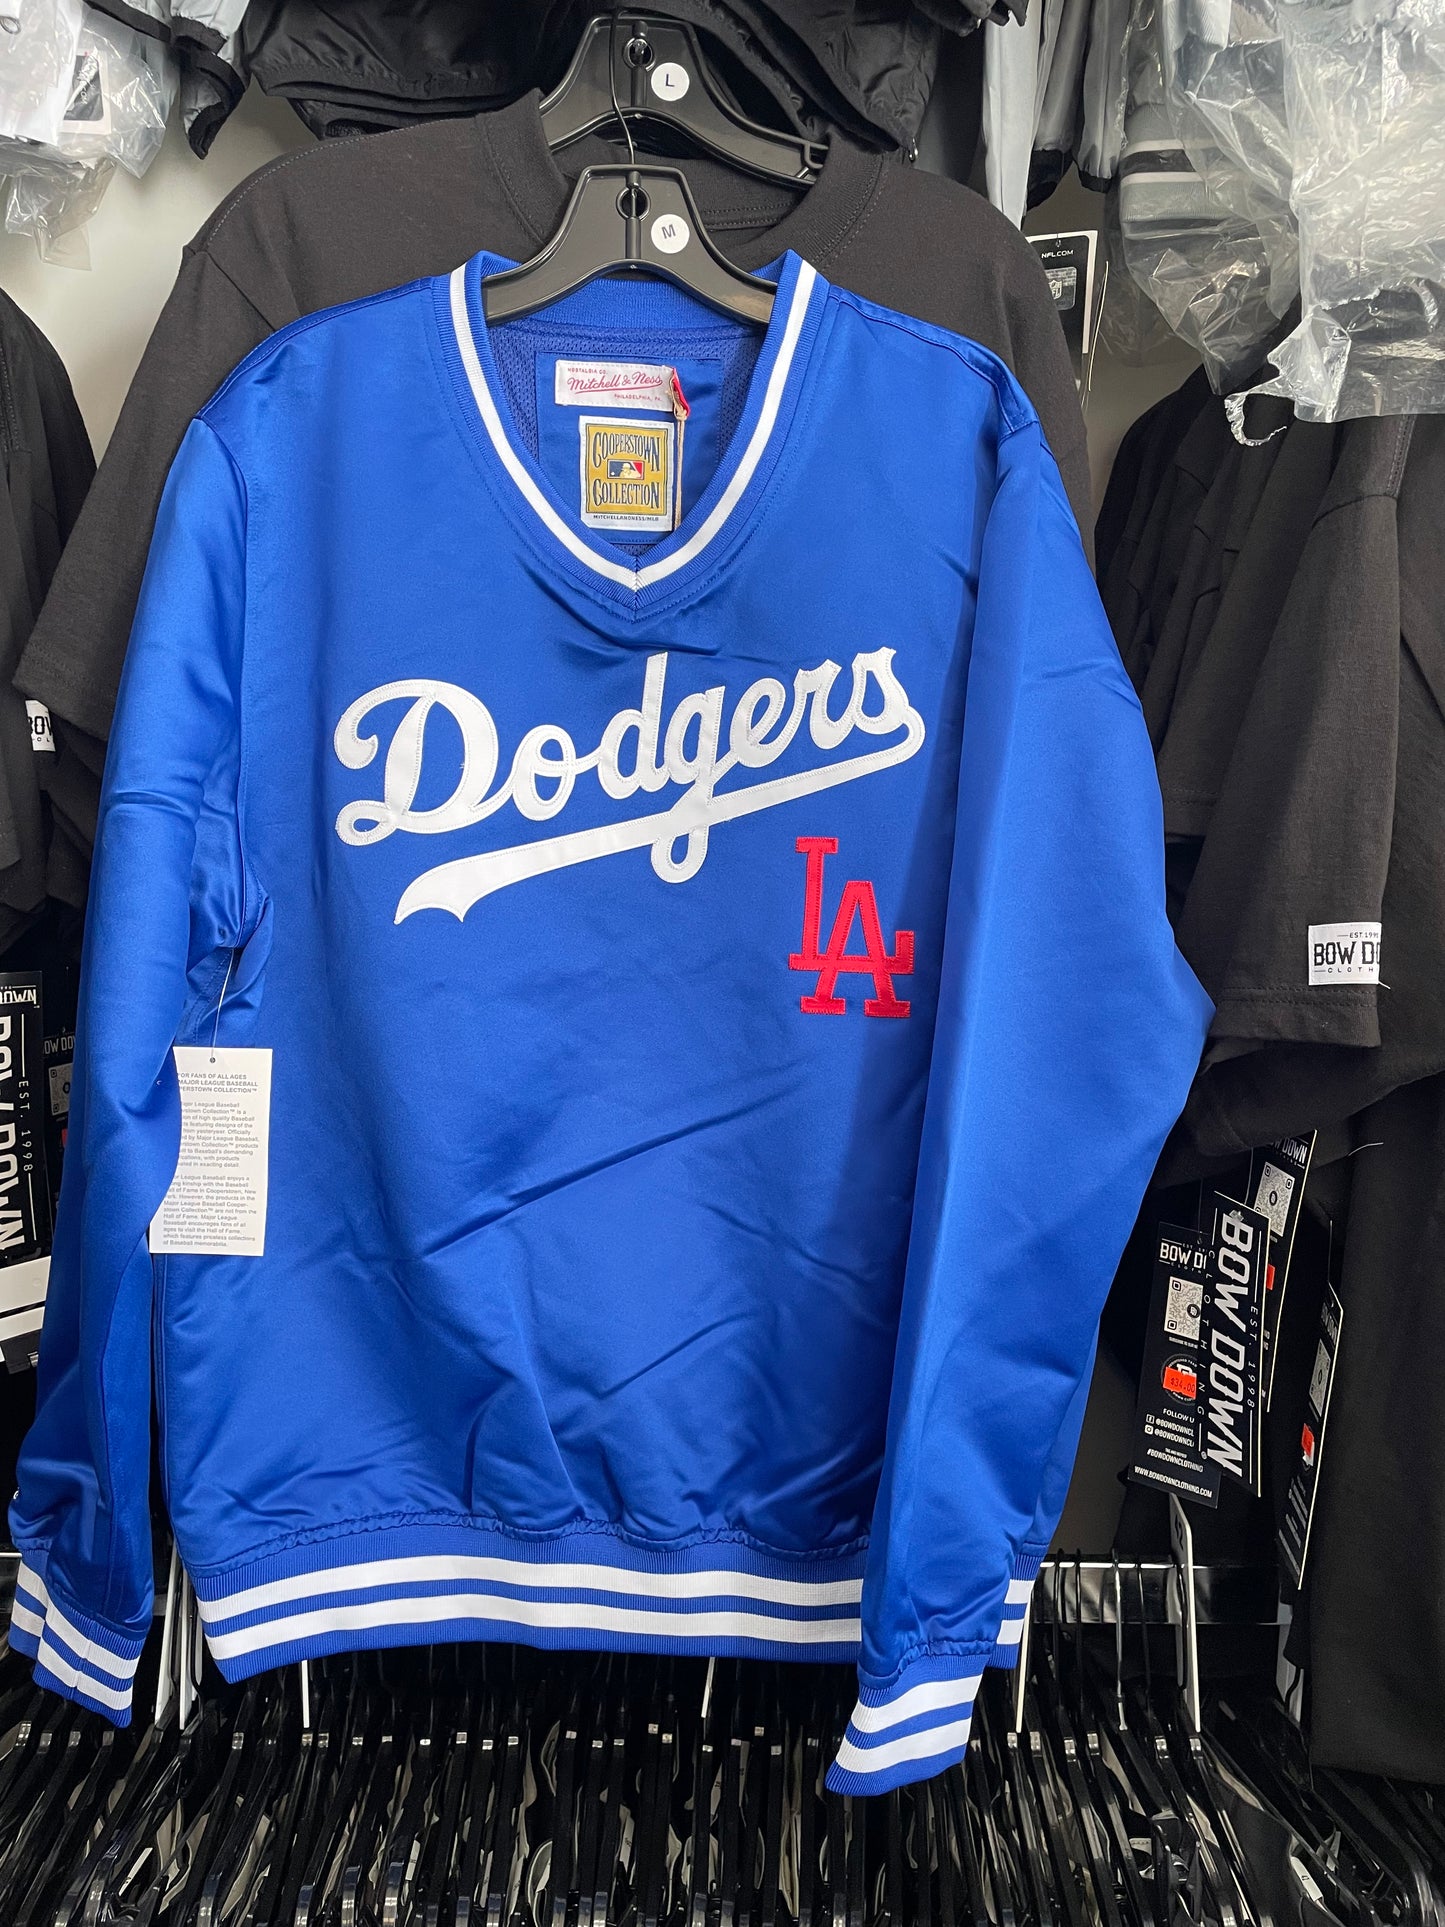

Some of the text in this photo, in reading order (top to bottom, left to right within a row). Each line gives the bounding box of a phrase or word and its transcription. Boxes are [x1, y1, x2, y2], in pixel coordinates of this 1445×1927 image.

[664, 73, 675, 88] L
[661, 224, 676, 240] M
[567, 372, 664, 391] Mitchell & Ness
[593, 432, 660, 472] COOPERSTOWN
[593, 478, 660, 509] COLLECTION
[334, 647, 926, 884] Dodgers
[788, 836, 915, 1018] LA
[1314, 941, 1356, 966] BOW
[0, 989, 37, 1004] OWN
[21, 1129, 34, 1172] 1998
[1160, 1242, 1192, 1265] BOW
[1207, 1213, 1254, 1478] BOW DOWN
[1170, 1376, 1196, 1393] $34.00
[1246, 1360, 1256, 1408] 1998
[1162, 1408, 1188, 1422] FOLLOW
